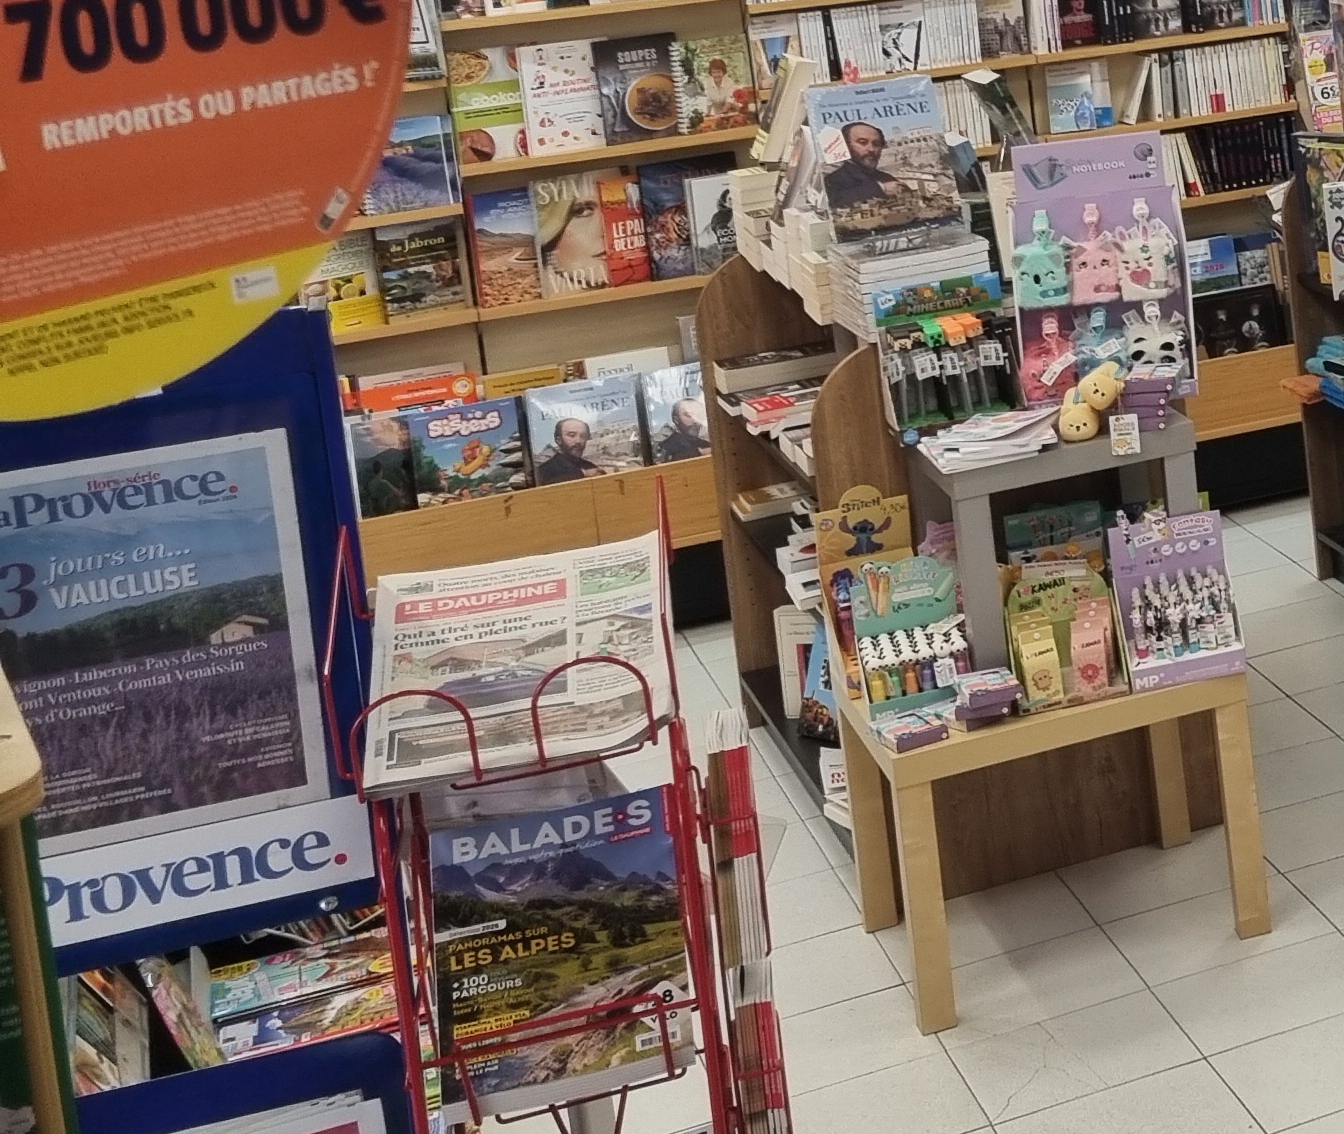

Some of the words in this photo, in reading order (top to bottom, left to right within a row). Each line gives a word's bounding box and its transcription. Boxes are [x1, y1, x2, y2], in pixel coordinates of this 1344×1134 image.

[41, 94, 194, 151] REMPORTÉS
[198, 88, 236, 117] OU
[240, 63, 359, 112] PARTAGÉS
[821, 107, 869, 125] PAUL
[874, 96, 931, 118] ARÈNE
[1072, 160, 1126, 174] NOTEBOOK
[403, 235, 446, 252] Jabron
[906, 297, 974, 315] MINECRAFT
[50, 563, 199, 610] VAUCLUSE
[404, 600, 433, 615] LE
[209, 638, 268, 659] Sorgues
[525, 927, 548, 939] SUR
[451, 951, 493, 971] LES
[499, 932, 576, 961] ALPES
[452, 978, 523, 1000] PARCOURS
